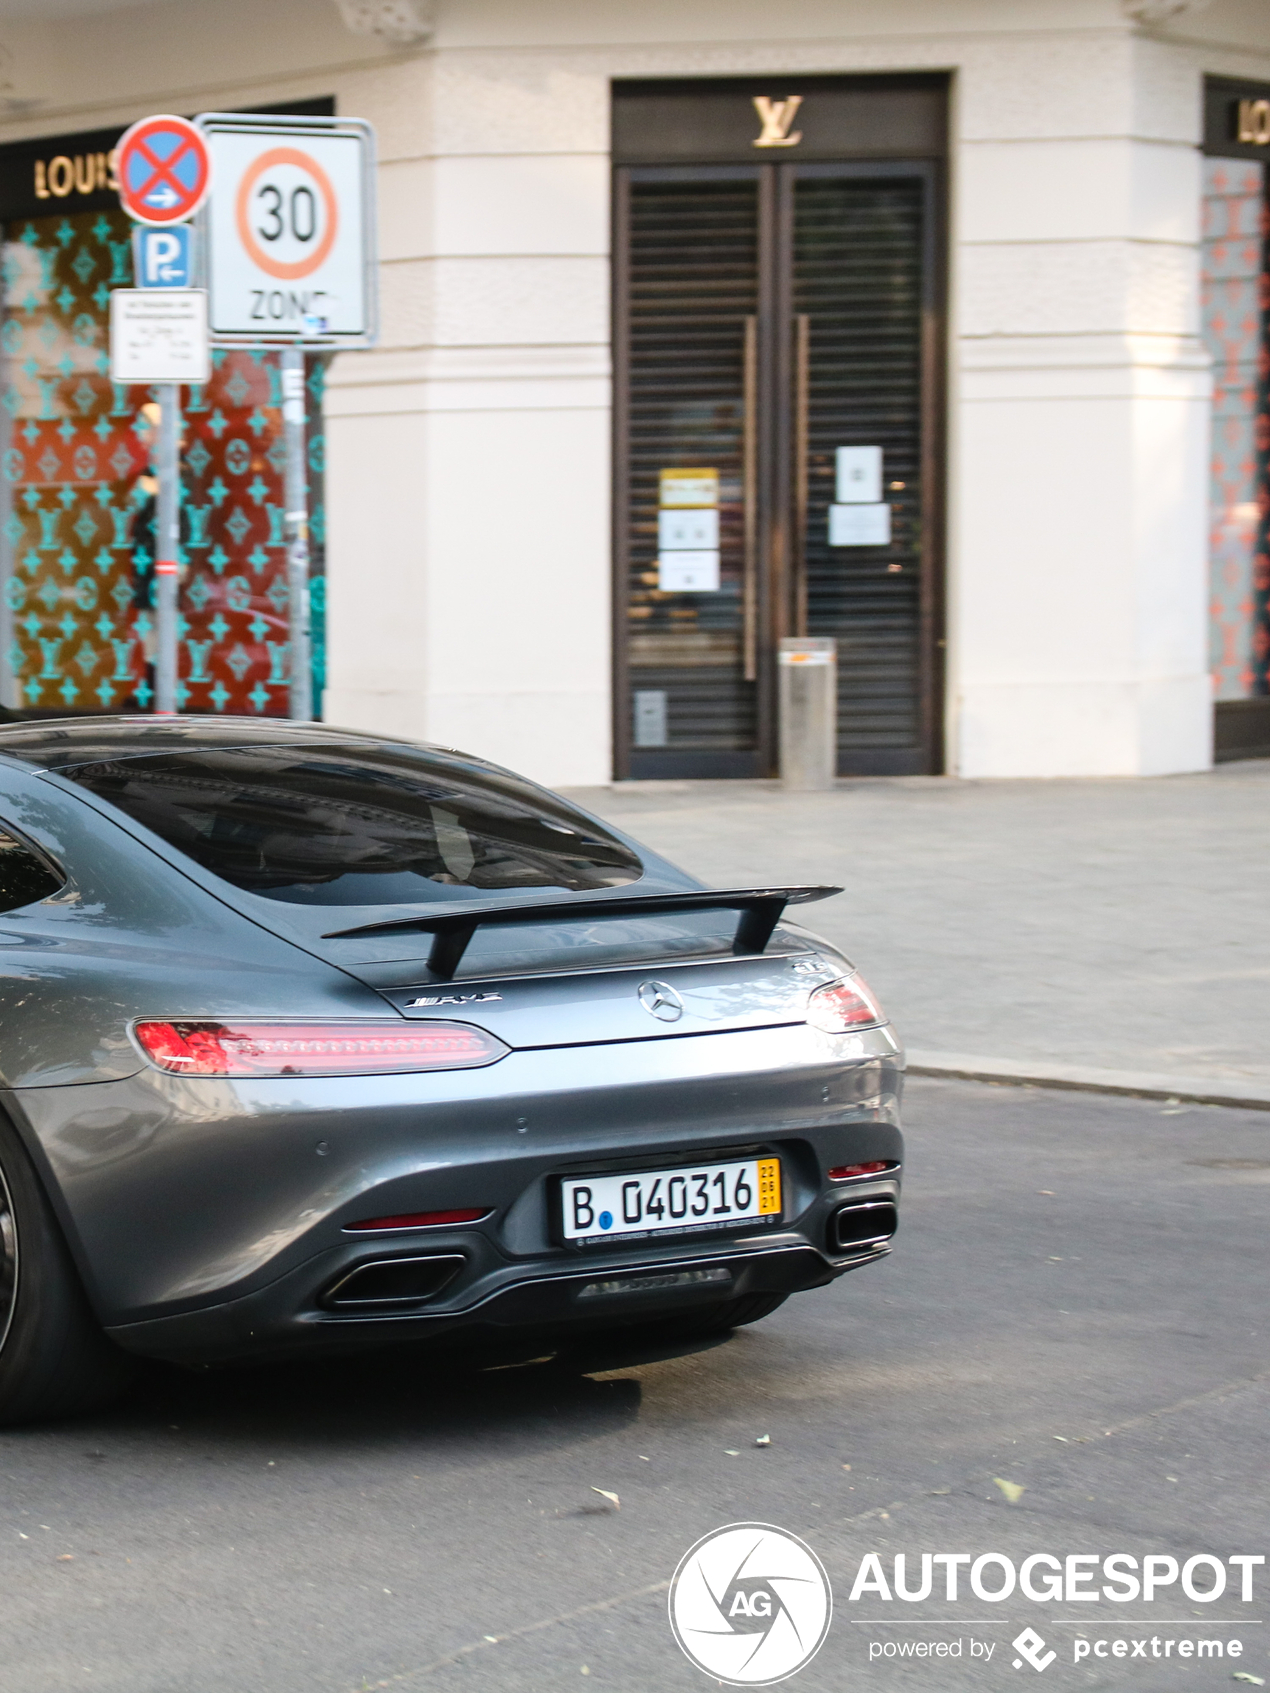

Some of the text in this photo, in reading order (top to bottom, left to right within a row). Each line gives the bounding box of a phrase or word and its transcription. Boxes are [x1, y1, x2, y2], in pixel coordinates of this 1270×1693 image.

[257, 184, 315, 242] 30
[146, 232, 181, 282] P
[761, 1165, 775, 1178] 22
[573, 1167, 752, 1230] B 040316
[762, 1195, 776, 1209] 21
